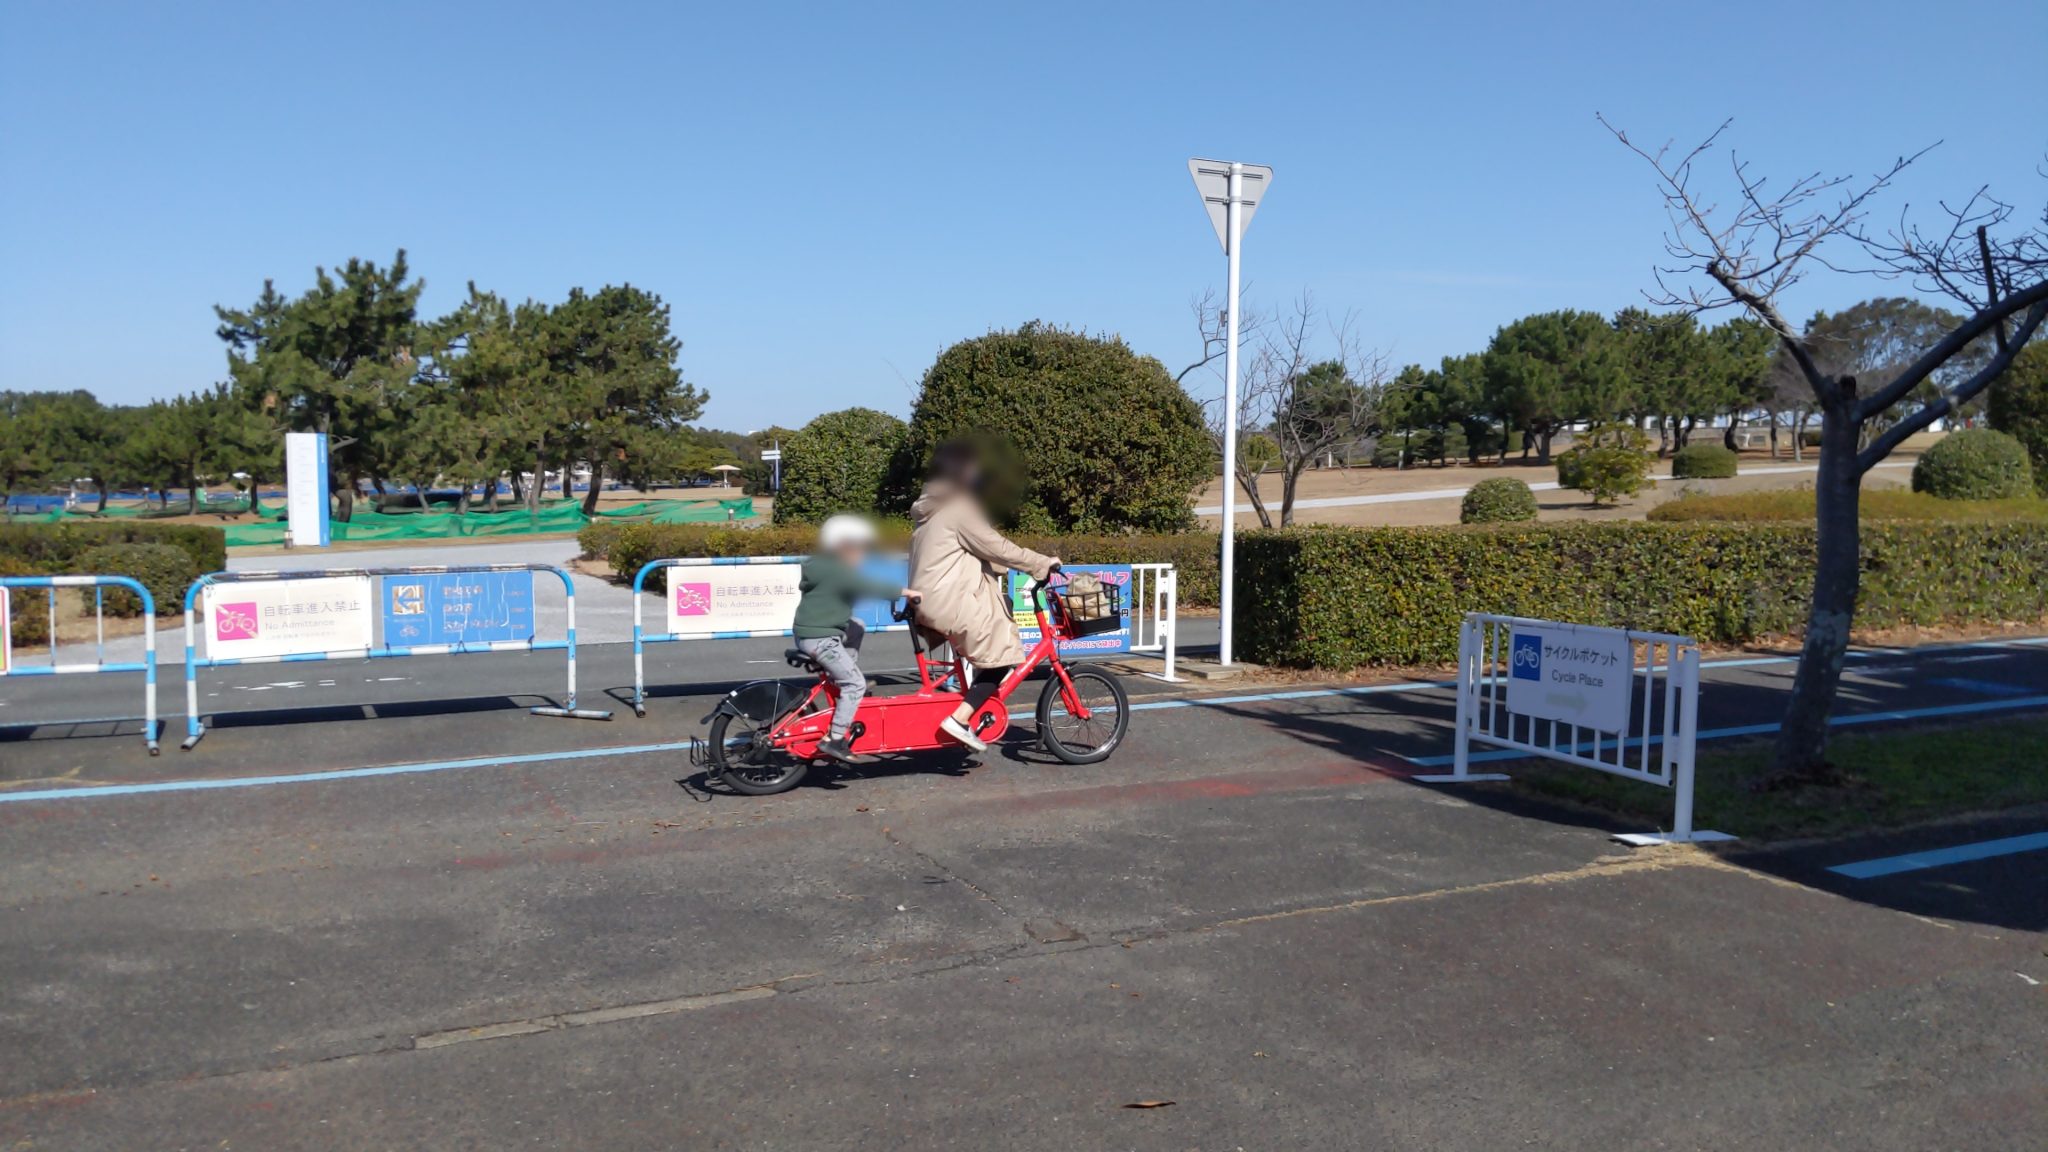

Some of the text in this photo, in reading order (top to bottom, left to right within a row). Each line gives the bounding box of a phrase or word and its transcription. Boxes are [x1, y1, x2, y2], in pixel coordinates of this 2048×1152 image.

[716, 584, 795, 597] 自転車進入禁止
[264, 600, 360, 617] 自転車進入禁止
[265, 619, 335, 631] No Admittance
[1544, 645, 1618, 666] サイクルポケット
[1552, 669, 1604, 687] Cycle Place
